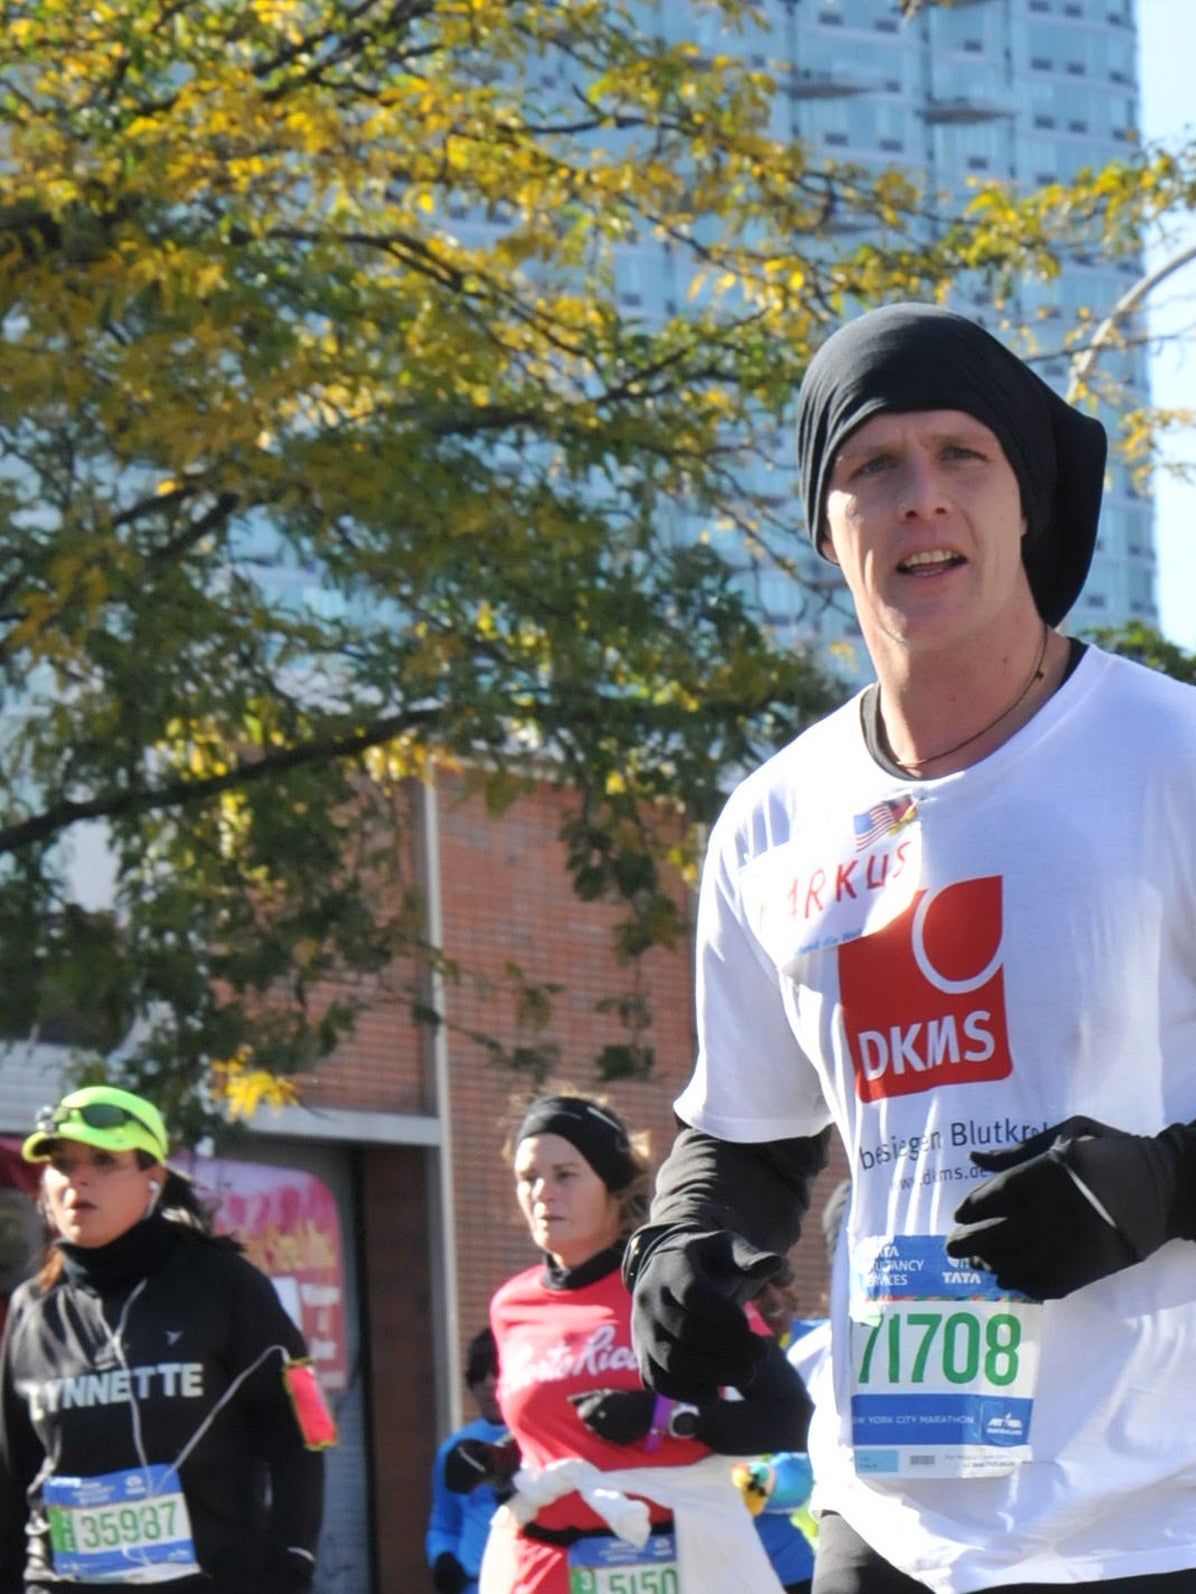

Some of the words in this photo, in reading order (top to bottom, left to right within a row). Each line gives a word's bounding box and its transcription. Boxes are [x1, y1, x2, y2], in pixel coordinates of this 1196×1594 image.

[858, 1010, 996, 1081] DKMS
[941, 1272, 982, 1284] TATA
[858, 1312, 1022, 1386] 71708
[28, 1362, 204, 1422] LYNNETTE
[868, 1416, 893, 1424] YORK
[896, 1416, 917, 1424] CITY
[919, 1415, 975, 1425] MARATHON
